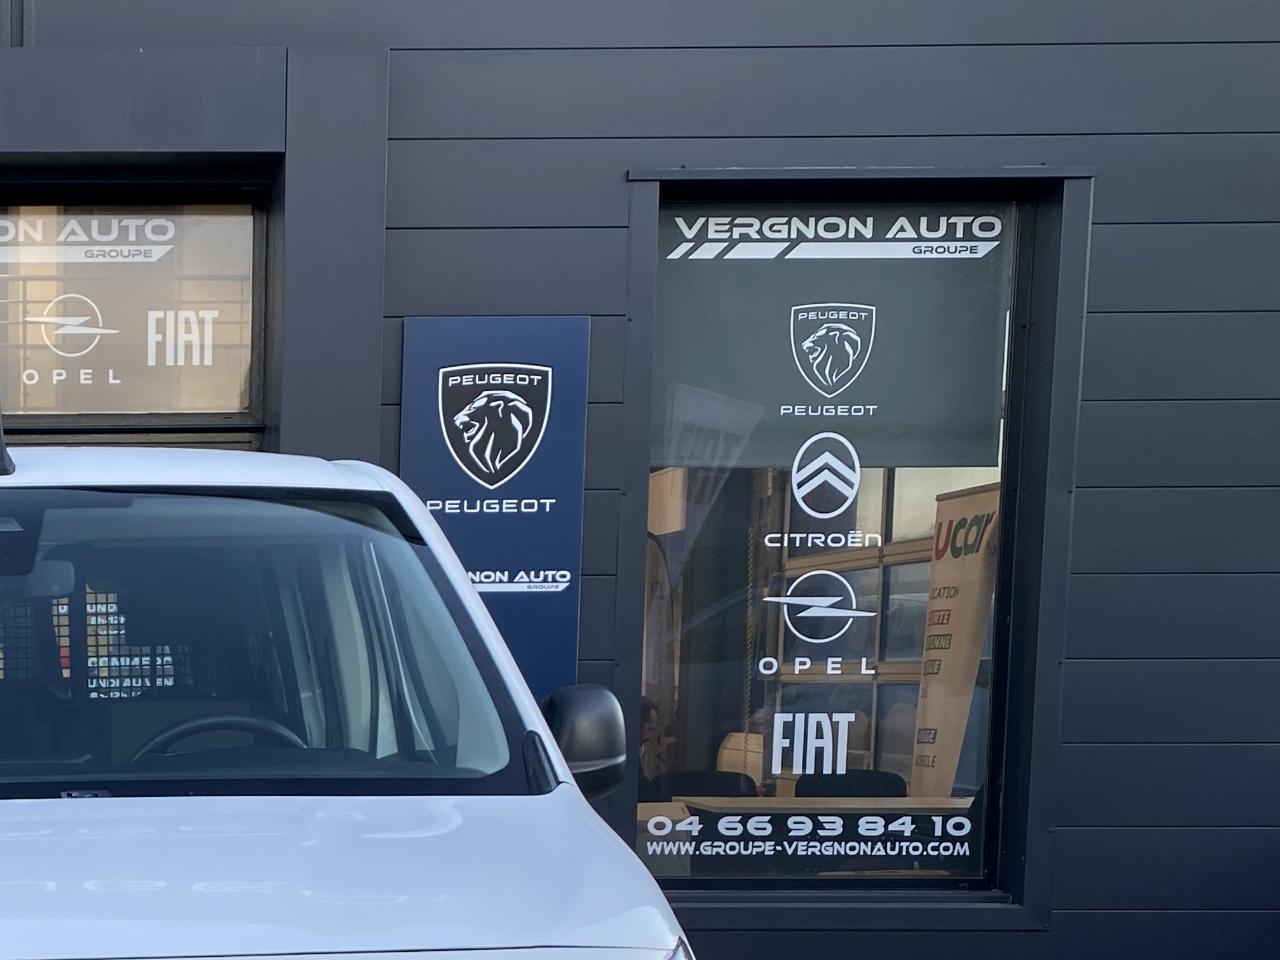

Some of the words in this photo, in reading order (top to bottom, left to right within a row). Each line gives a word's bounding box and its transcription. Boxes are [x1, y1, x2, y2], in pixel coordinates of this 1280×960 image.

[56, 218, 176, 242] AUTO
[674, 216, 874, 240] VERGNON
[885, 216, 1003, 239] AUTO
[84, 248, 153, 259] GROUPE
[911, 244, 980, 255] GROUPE
[798, 310, 869, 321] PEUGEOT
[147, 310, 219, 367] FIAT
[22, 368, 122, 385] OPEL
[448, 373, 543, 387] PEUGEOT
[780, 405, 878, 416] PEUGEOT
[426, 498, 557, 513] PEUGEOT
[513, 570, 571, 582] AUTO
[758, 656, 876, 675] OPEL
[771, 712, 856, 775] FIAT
[647, 815, 704, 836] 04
[717, 815, 773, 836] 66
[786, 815, 844, 836] 93
[857, 815, 916, 836] 84
[931, 815, 972, 836] 10
[647, 841, 971, 856] WWW.GROUPE-VERGNONAUTO.COM
